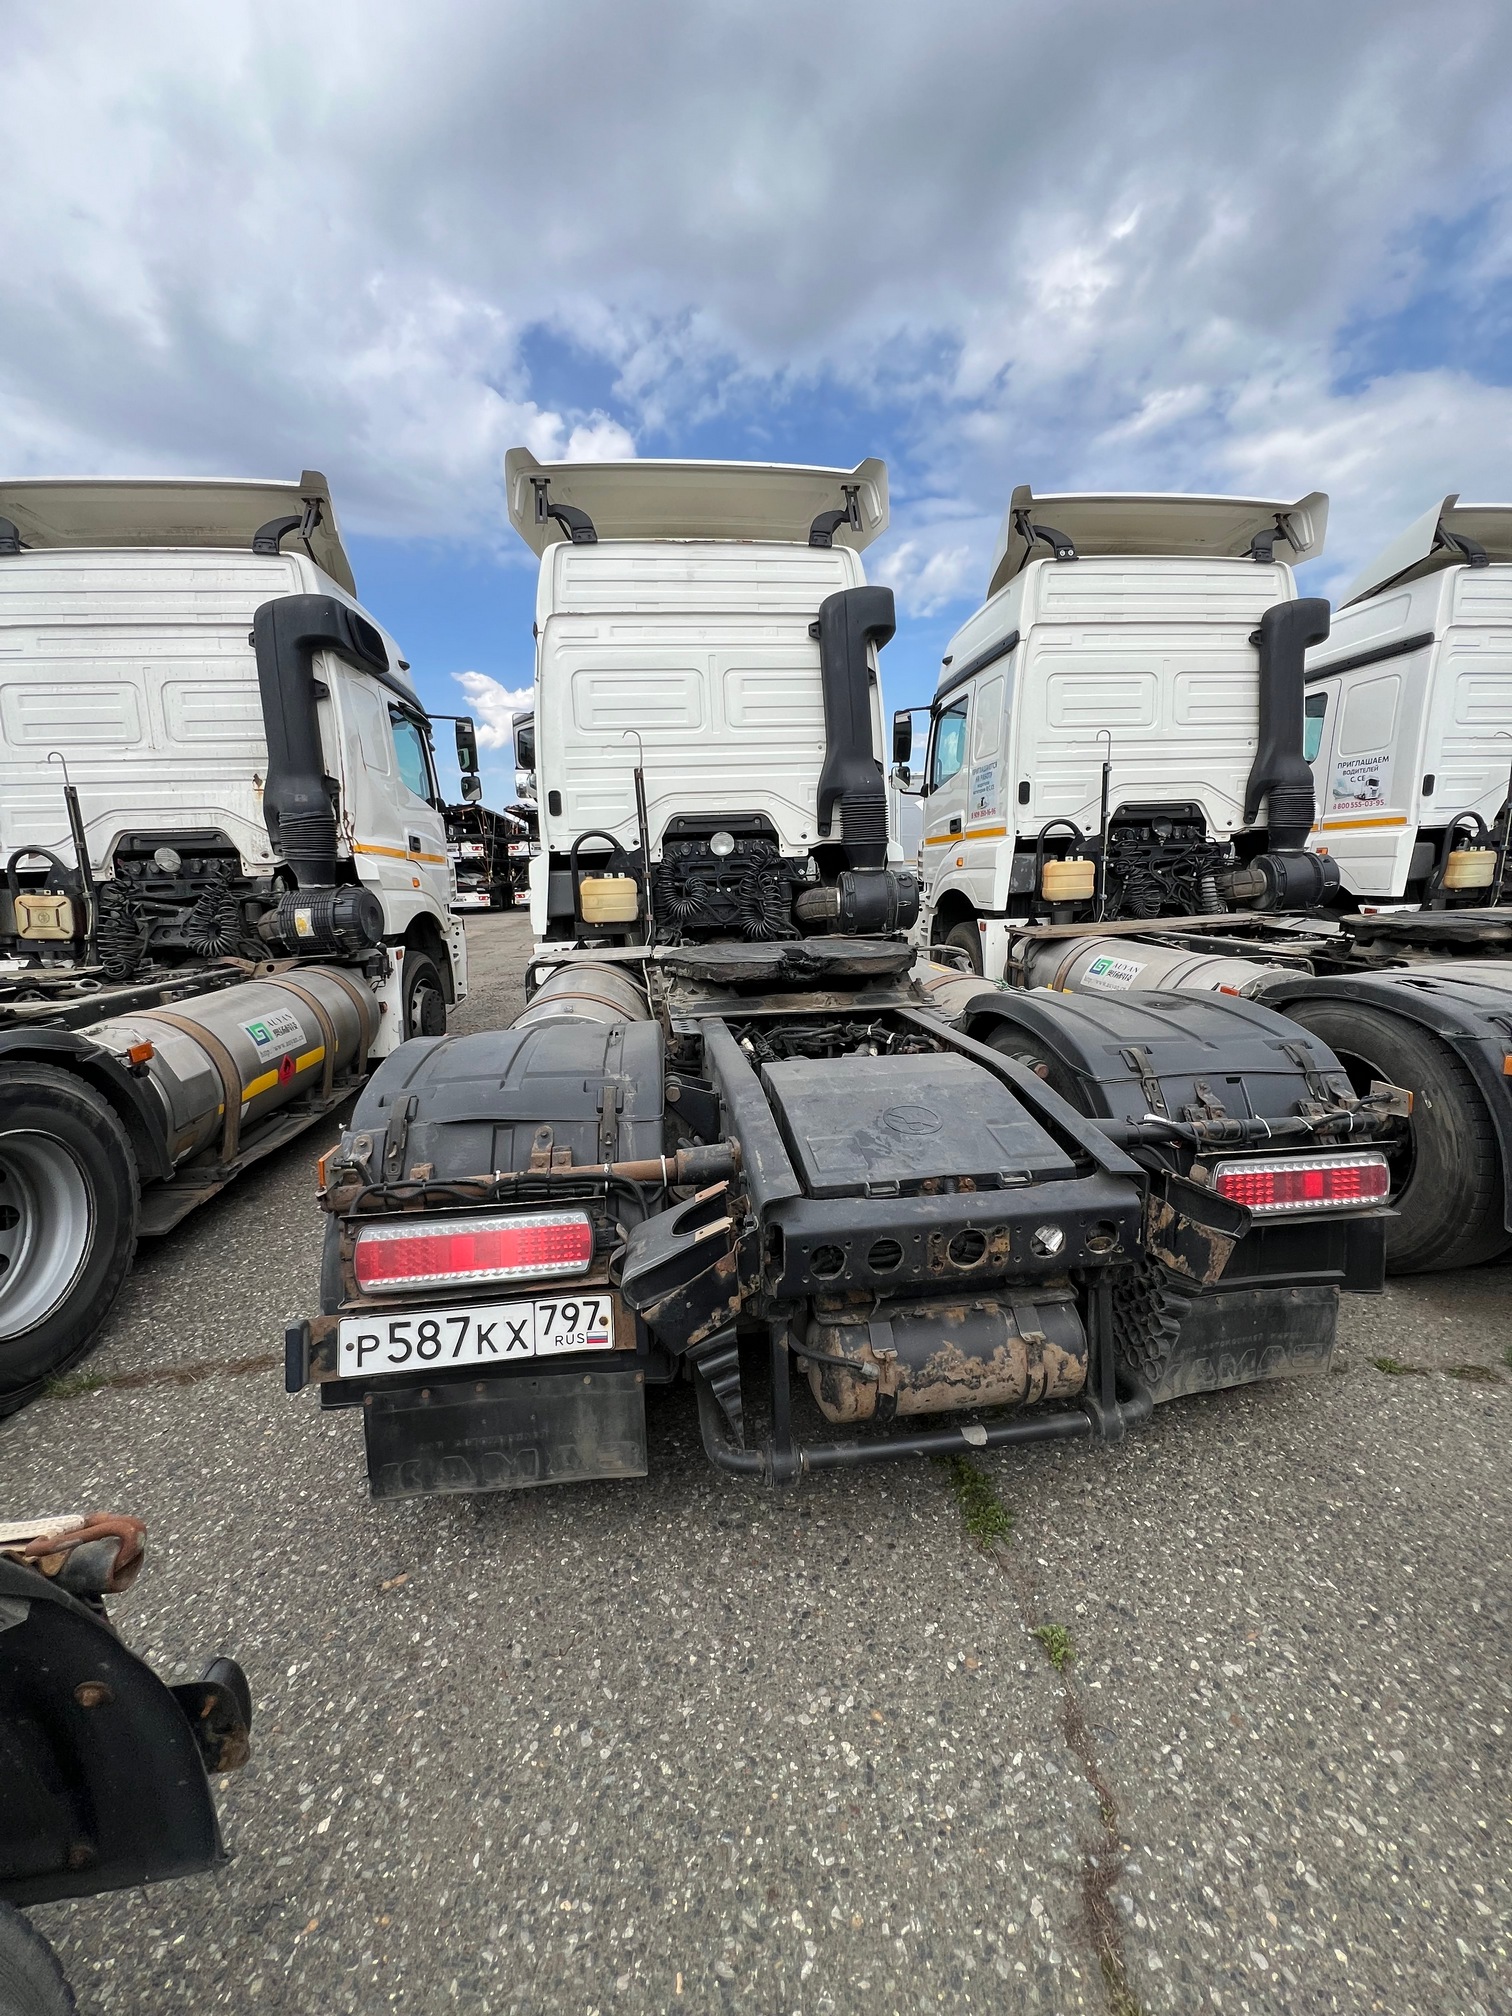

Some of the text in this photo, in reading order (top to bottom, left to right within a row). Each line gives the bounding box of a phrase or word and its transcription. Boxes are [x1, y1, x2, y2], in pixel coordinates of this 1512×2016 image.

[1337, 756, 1389, 769] ПРИГЛАШАЕМ
[1342, 765, 1379, 776] ВОДИТЕЛЕЙ
[1337, 802, 1350, 810] 800
[1350, 799, 1385, 808] 555-03-95
[1112, 963, 1140, 973] AUYAN
[357, 1301, 600, 1368] Р587КХ 797
[555, 1332, 585, 1346] RUS
